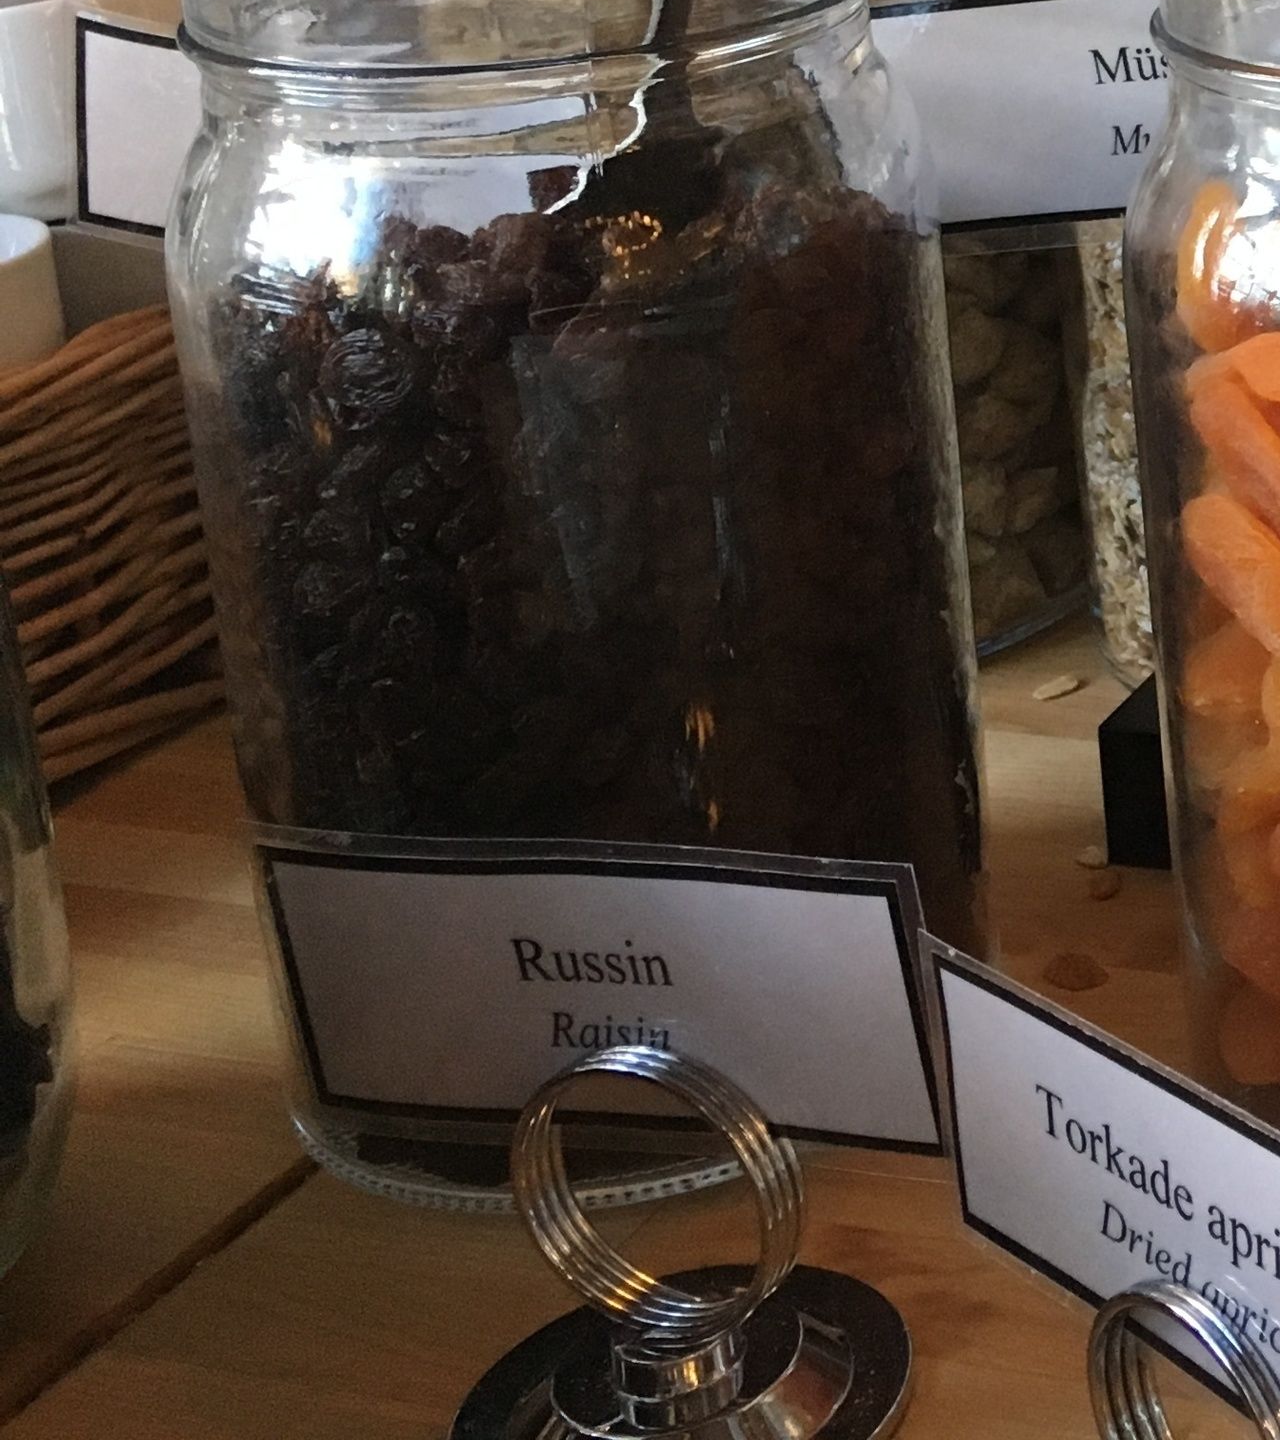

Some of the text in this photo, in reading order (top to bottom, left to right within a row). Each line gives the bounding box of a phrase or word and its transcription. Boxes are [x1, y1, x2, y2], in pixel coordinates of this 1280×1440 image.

[510, 938, 674, 987] Russin
[550, 1011, 672, 1051] Raisin
[1035, 1083, 1194, 1222] Torkade
[1099, 1199, 1194, 1289] Dried
